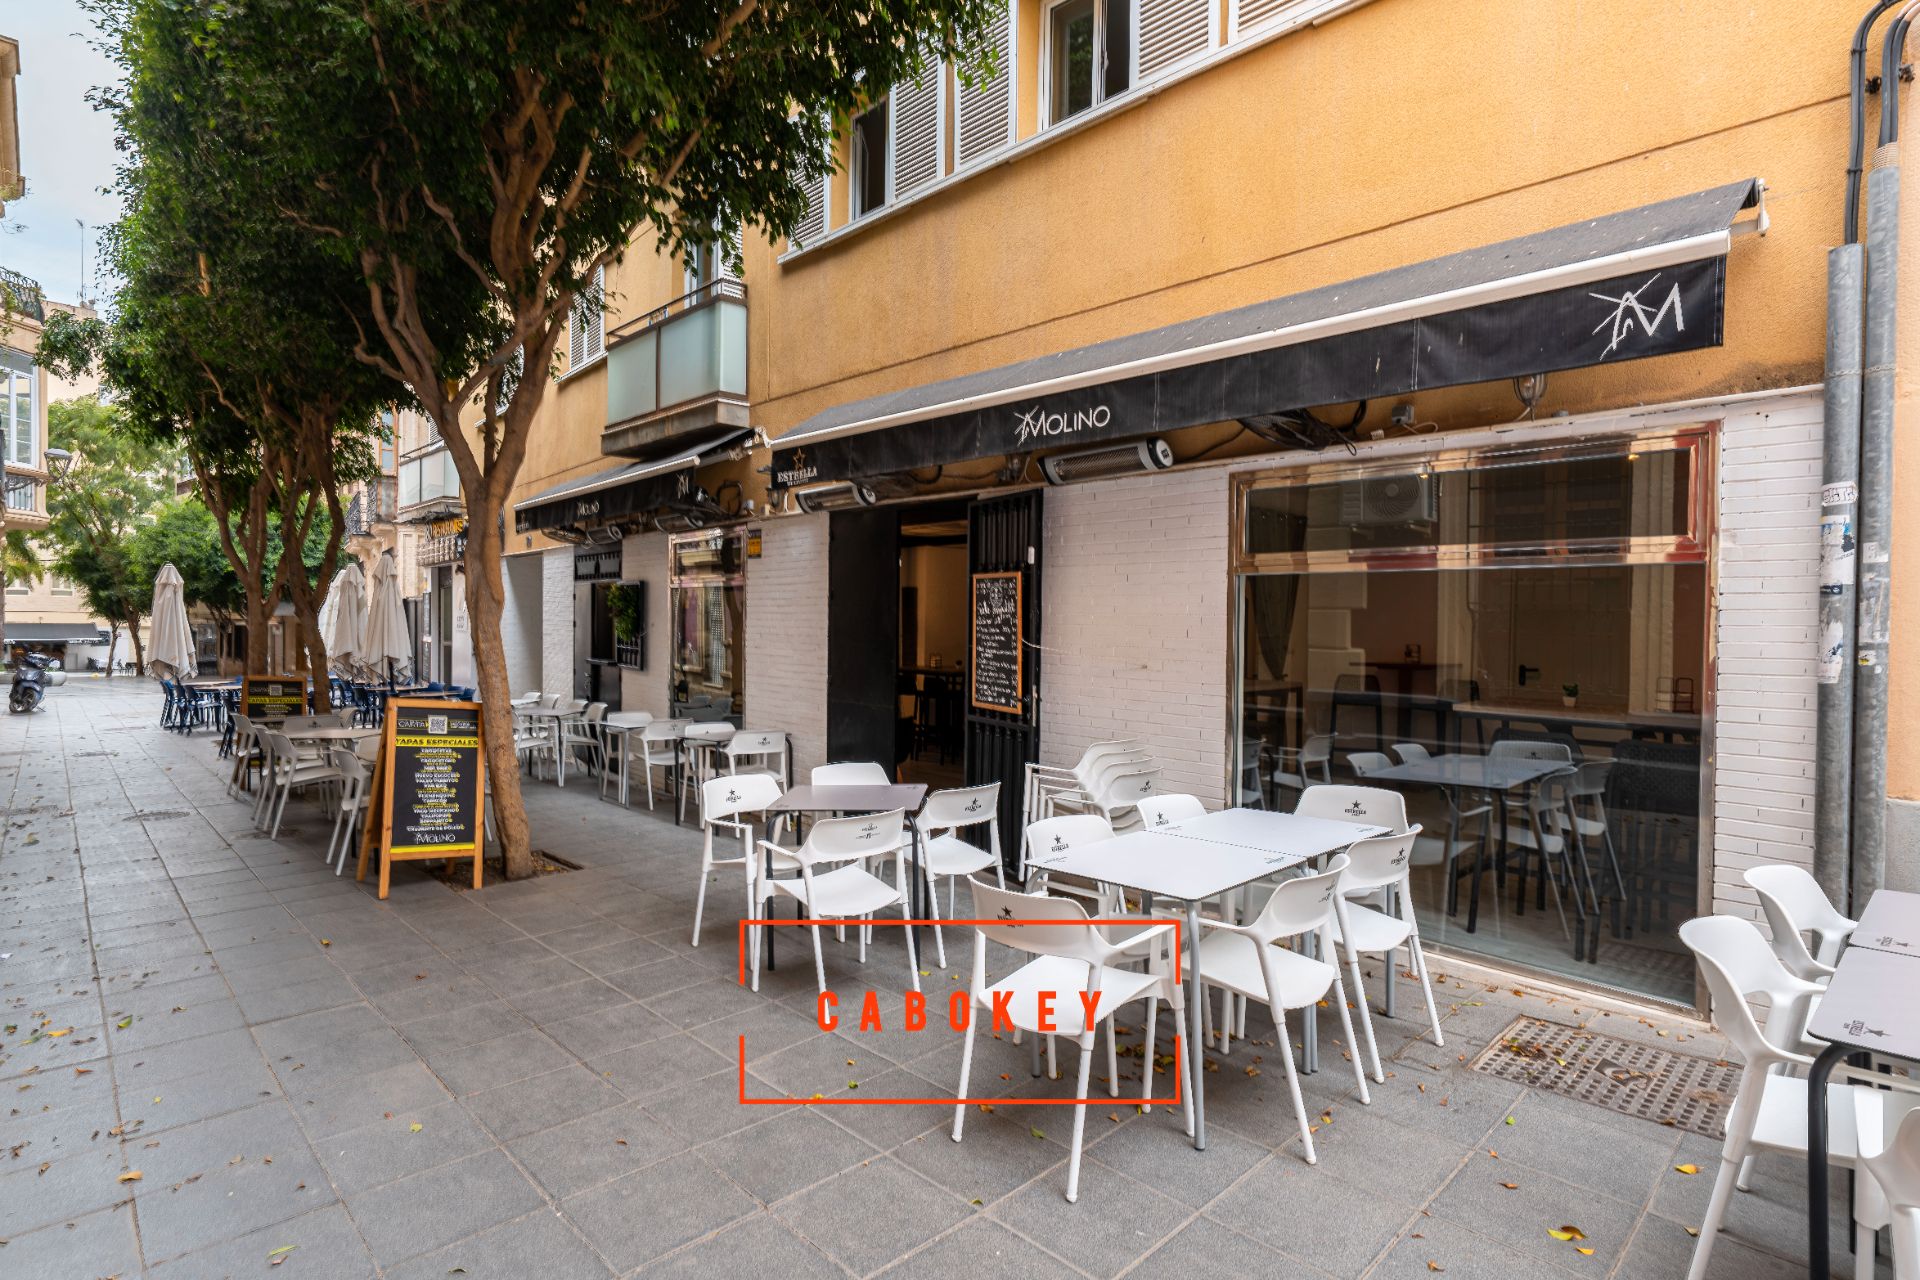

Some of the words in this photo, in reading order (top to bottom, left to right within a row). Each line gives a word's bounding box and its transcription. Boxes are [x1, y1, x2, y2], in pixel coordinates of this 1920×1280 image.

[1013, 405, 1111, 448] MOLINO
[777, 466, 818, 483] ESTRELLA
[398, 719, 425, 728] CARTA
[396, 738, 424, 746] TAPAS
[415, 833, 456, 844] MOLINO
